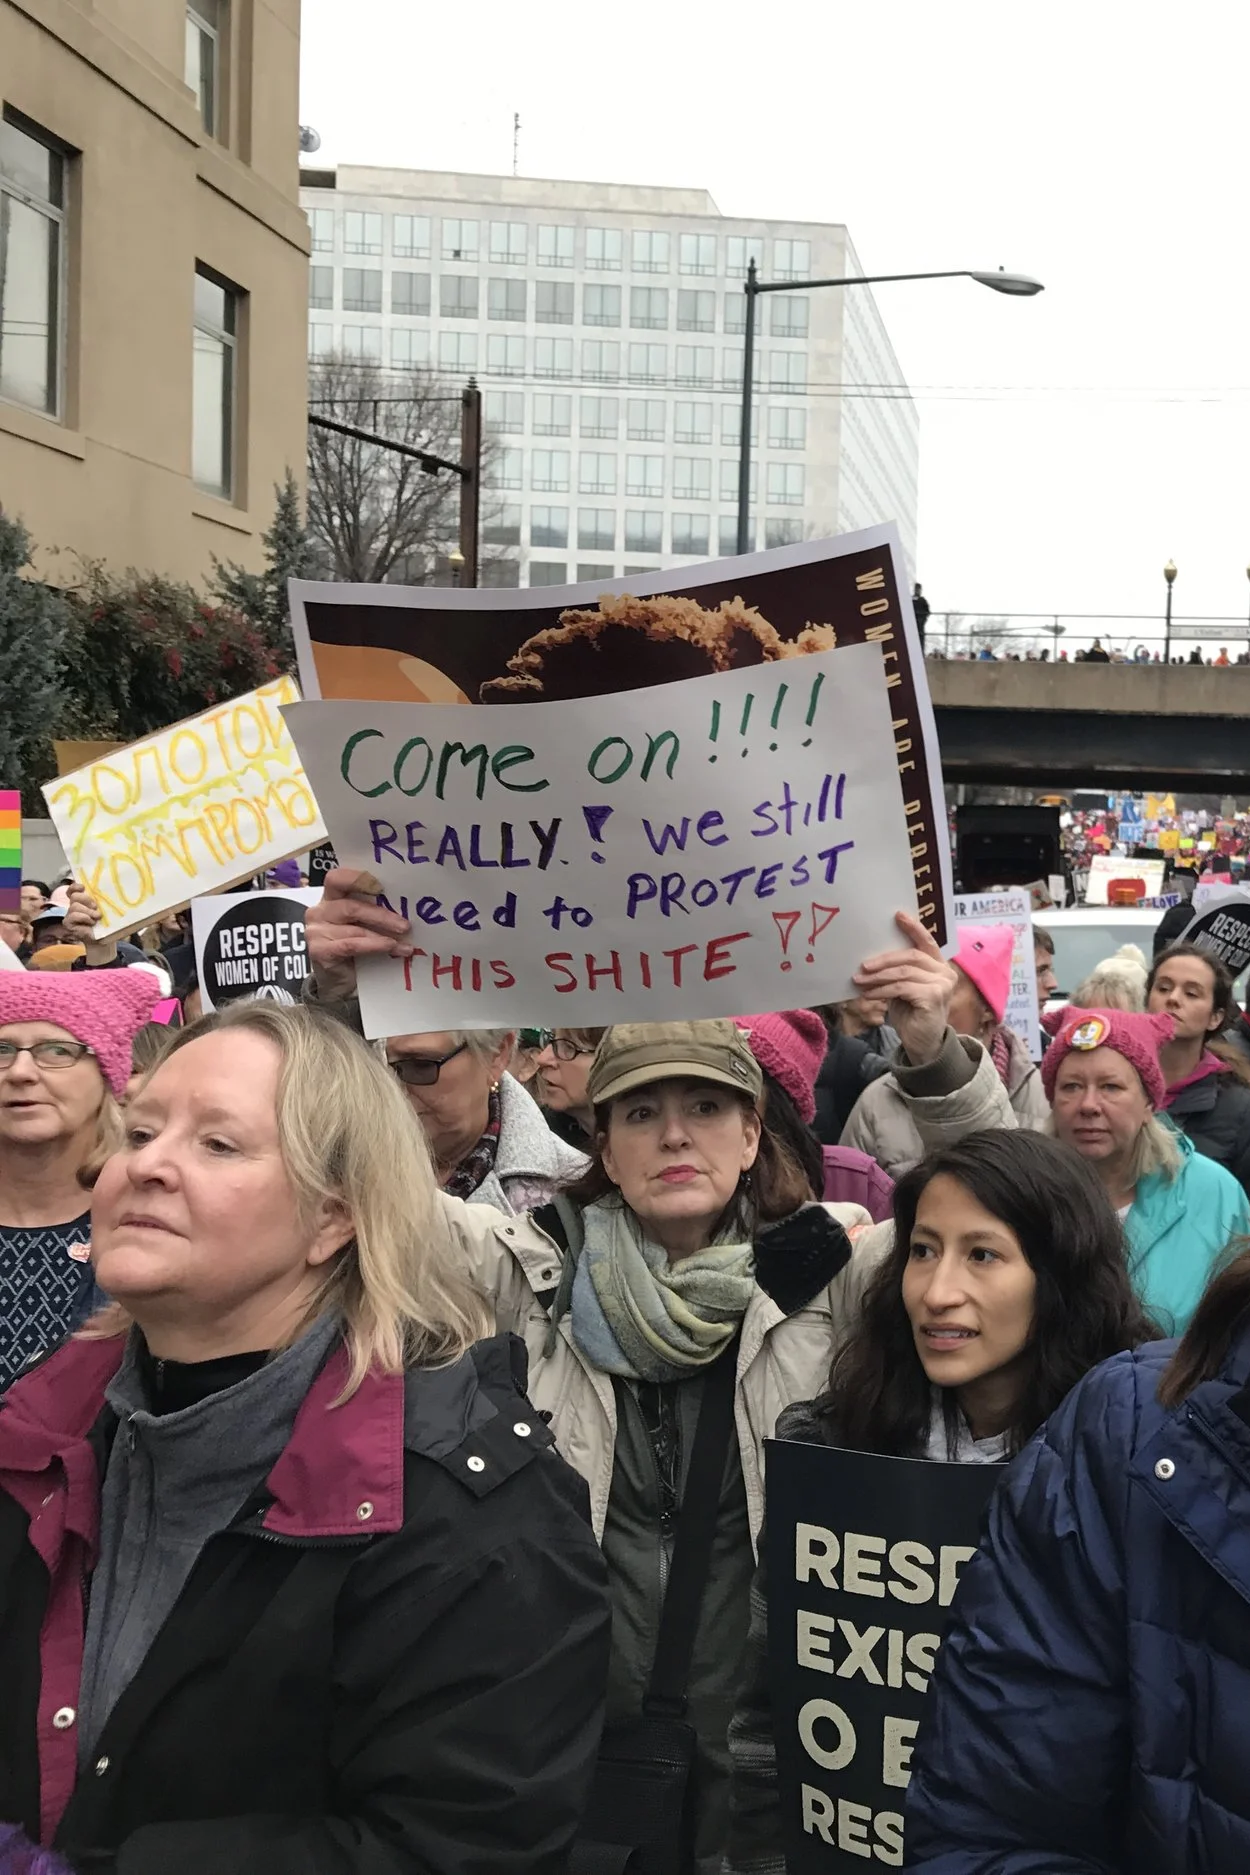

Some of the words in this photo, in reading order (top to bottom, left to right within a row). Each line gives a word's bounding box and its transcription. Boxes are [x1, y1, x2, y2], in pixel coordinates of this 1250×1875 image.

[80, 769, 318, 928] КОМПРОМА
[542, 895, 595, 931] to
[626, 840, 855, 919] PROTEST
[971, 898, 1026, 916] AMERICA
[214, 957, 259, 987] WOMEN
[262, 956, 279, 982] OF
[388, 947, 517, 993] THIS
